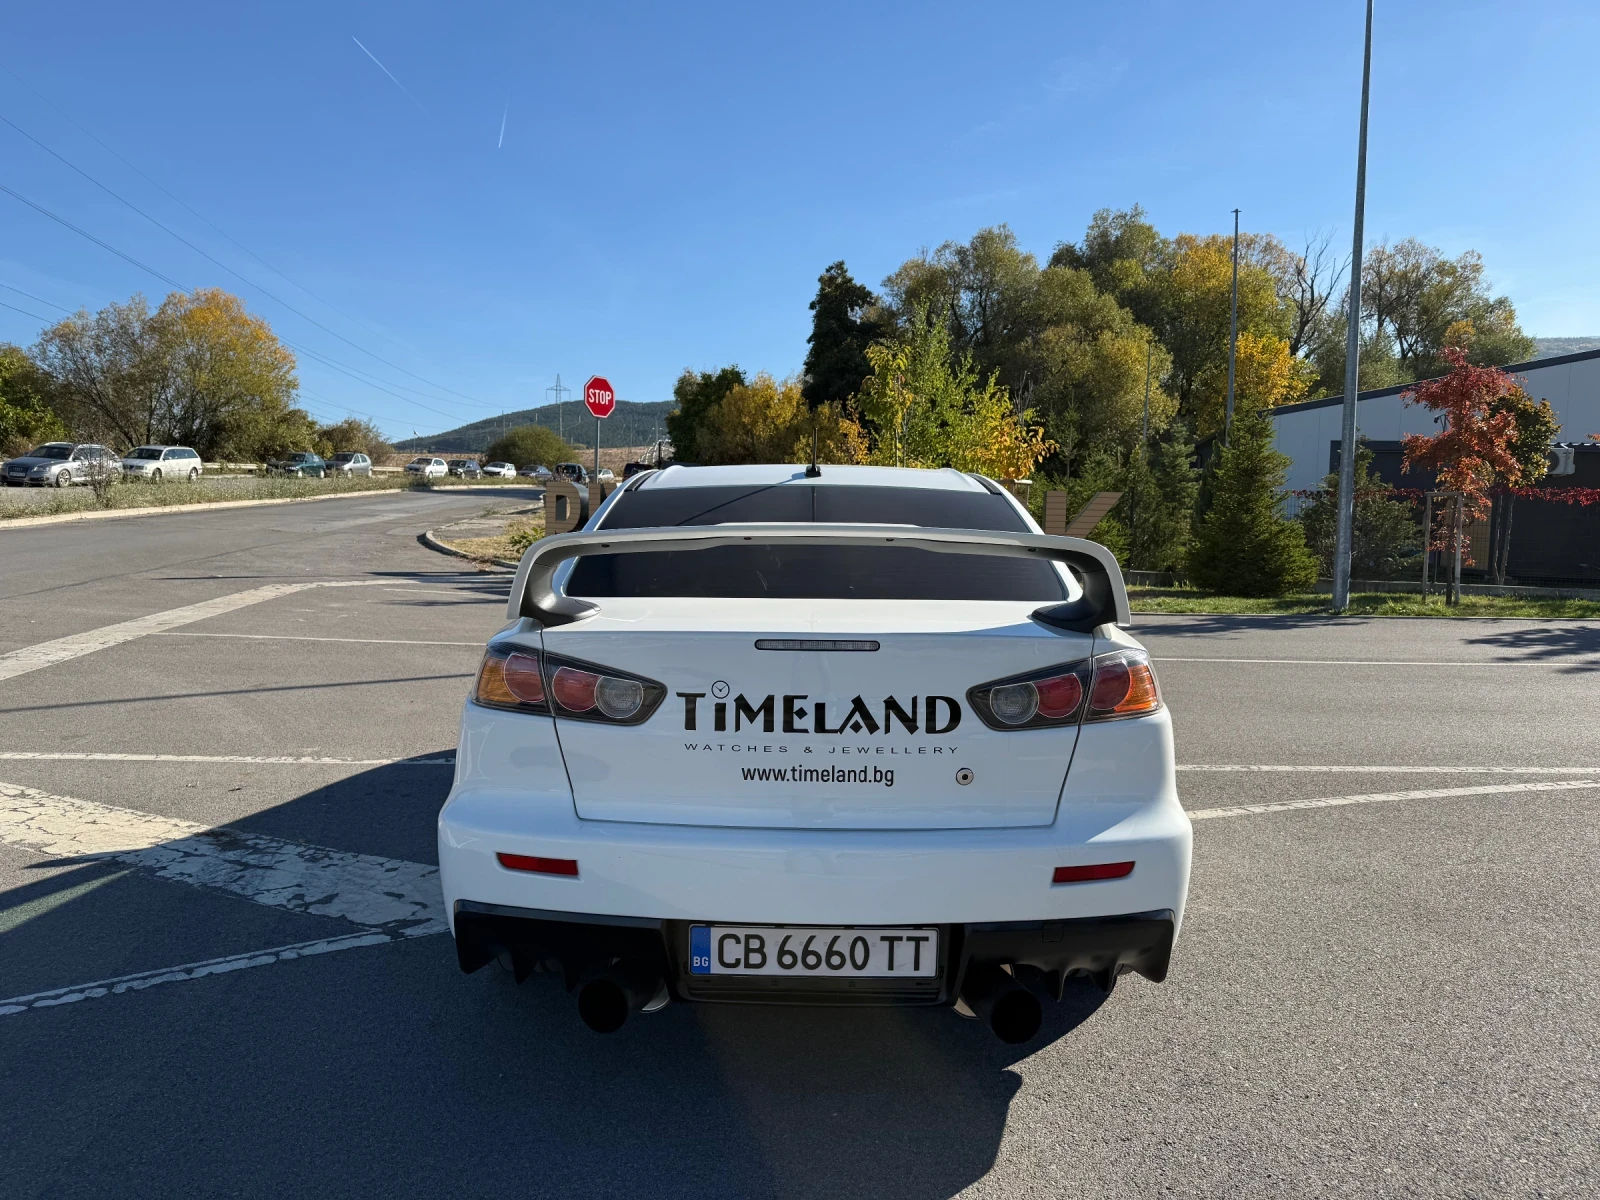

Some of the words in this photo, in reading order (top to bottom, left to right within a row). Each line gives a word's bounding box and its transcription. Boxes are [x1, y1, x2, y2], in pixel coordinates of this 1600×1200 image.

[588, 388, 612, 405] STOP
[684, 743, 788, 753] WATCHES
[803, 746, 813, 754] &
[828, 746, 958, 754] JEWELLERY
[741, 764, 895, 787] www.timeland.bg
[717, 933, 768, 969] CB
[776, 934, 870, 971] 6660
[880, 935, 930, 971] TT
[693, 956, 709, 967] BG
